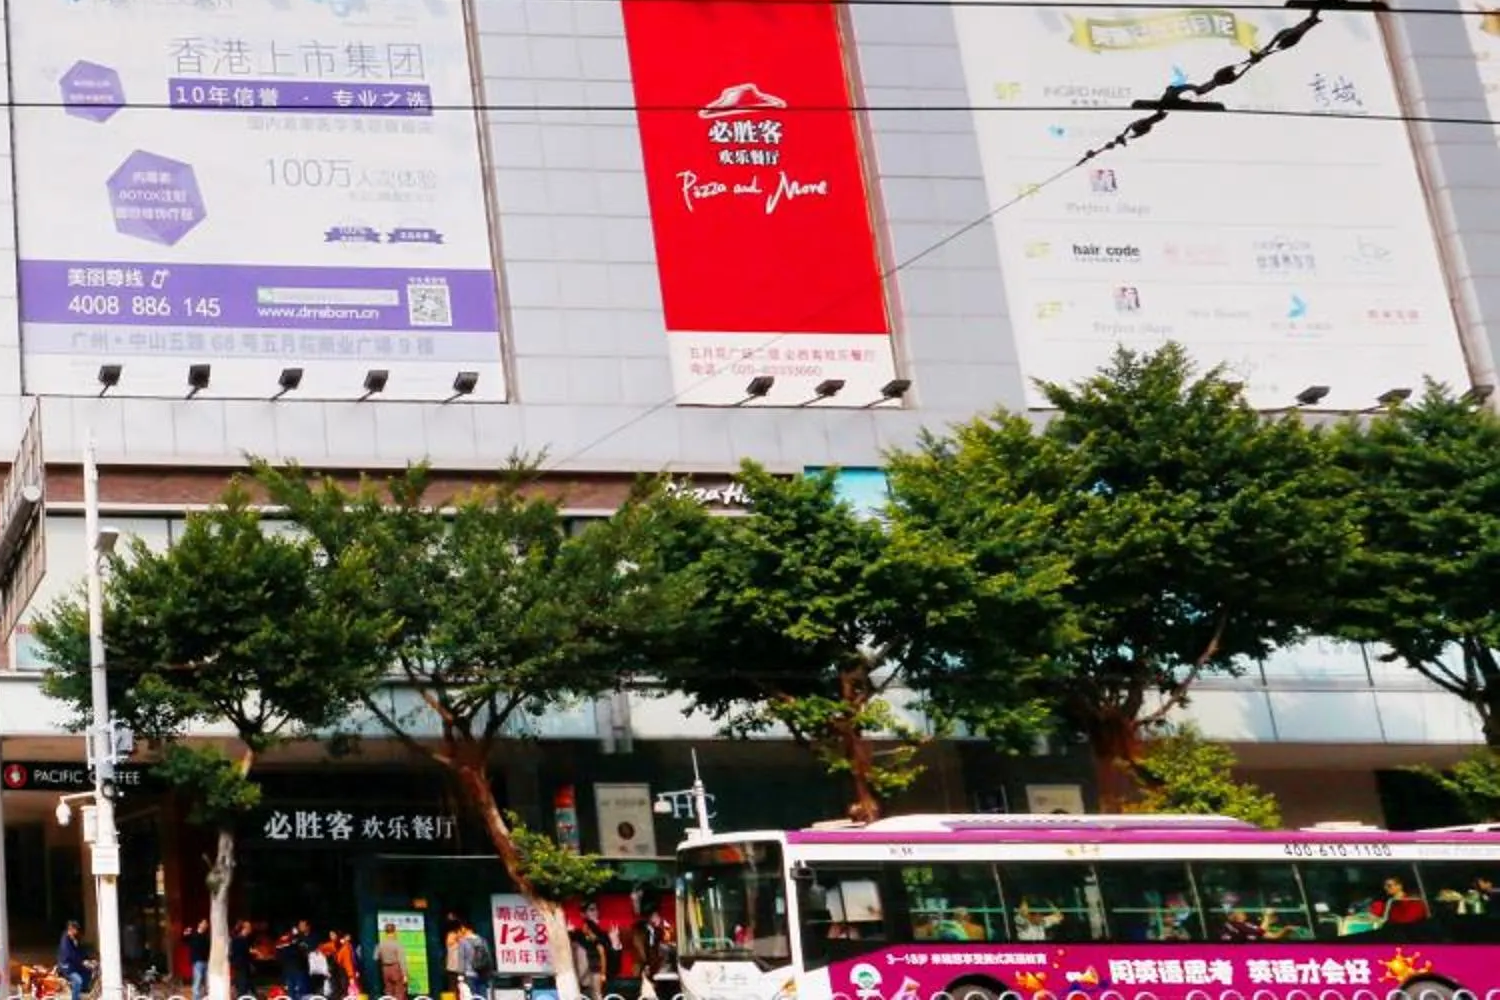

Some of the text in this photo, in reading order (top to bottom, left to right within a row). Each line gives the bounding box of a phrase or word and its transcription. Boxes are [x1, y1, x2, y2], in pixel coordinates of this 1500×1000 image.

[168, 36, 426, 80] 香港上市集团
[175, 85, 430, 110] 10年信誉 专业之选
[708, 119, 783, 144] 必胜客
[718, 149, 779, 166] 欢乐餐厅
[675, 169, 828, 215] Pizza and More
[1072, 243, 1141, 258] hair code
[67, 295, 222, 319] 4008 886 145
[33, 769, 141, 786] PACIFIC CFEE
[263, 809, 457, 841] 必胜客 欢乐餐厅
[1108, 958, 1373, 986] 用英语思考 英语才会好
